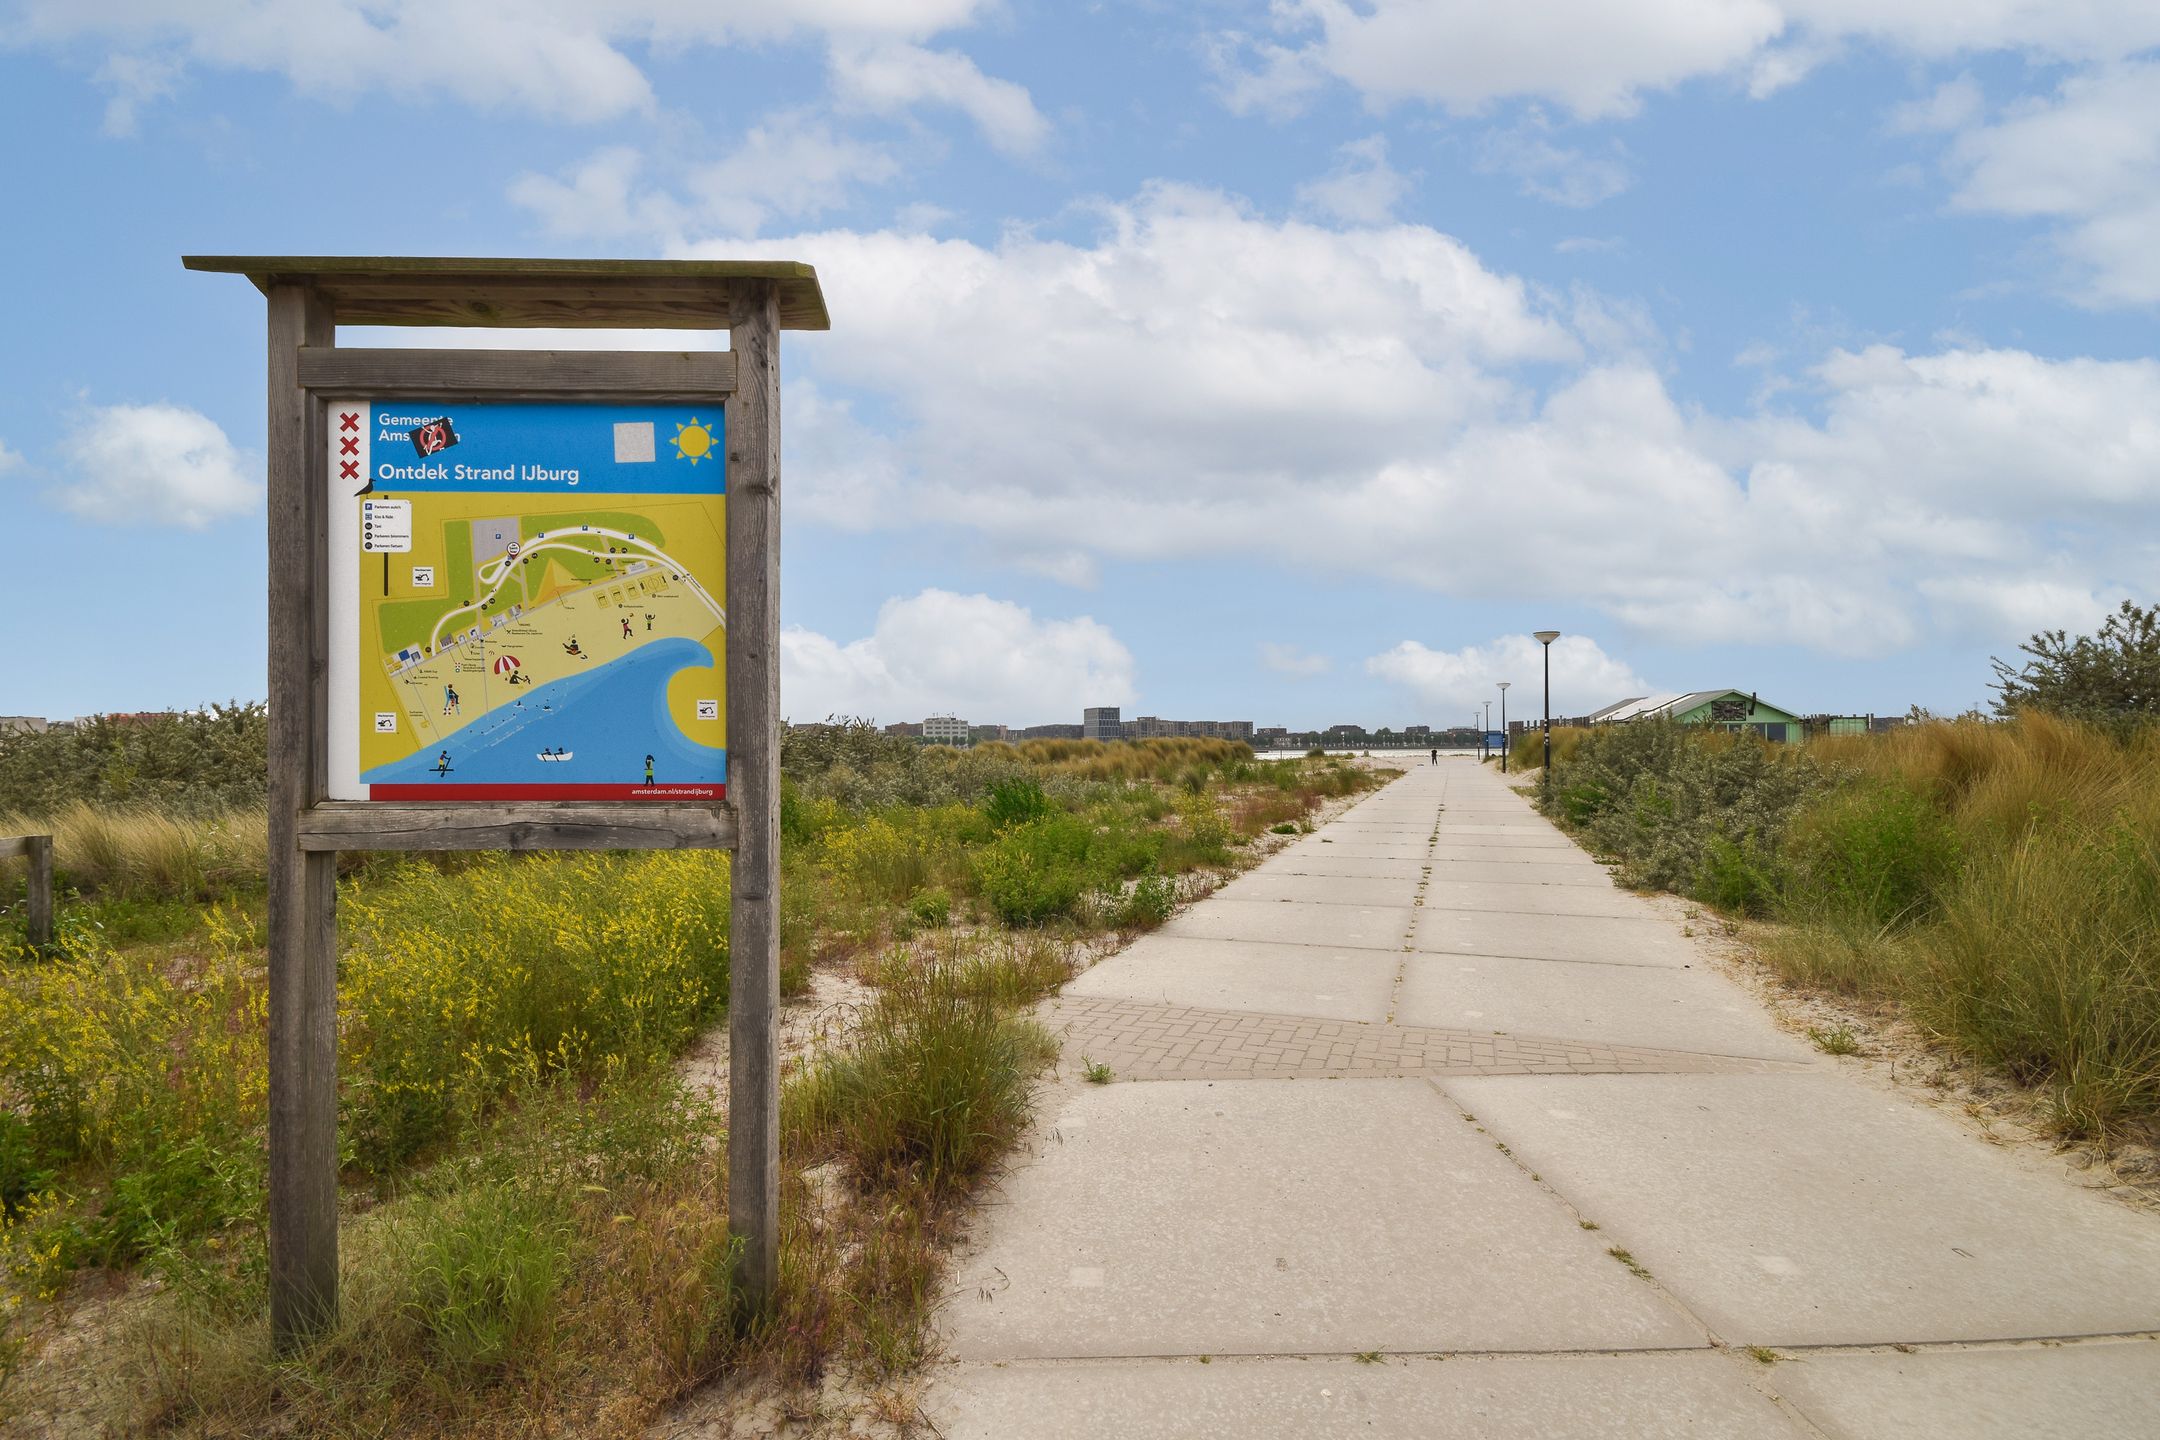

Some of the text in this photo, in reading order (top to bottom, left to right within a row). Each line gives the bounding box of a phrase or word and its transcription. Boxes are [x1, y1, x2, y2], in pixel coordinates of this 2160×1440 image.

[378, 463, 580, 486] Ontdek Strand IJburg
[631, 788, 713, 796] amsterdam.nl/strandijburg
